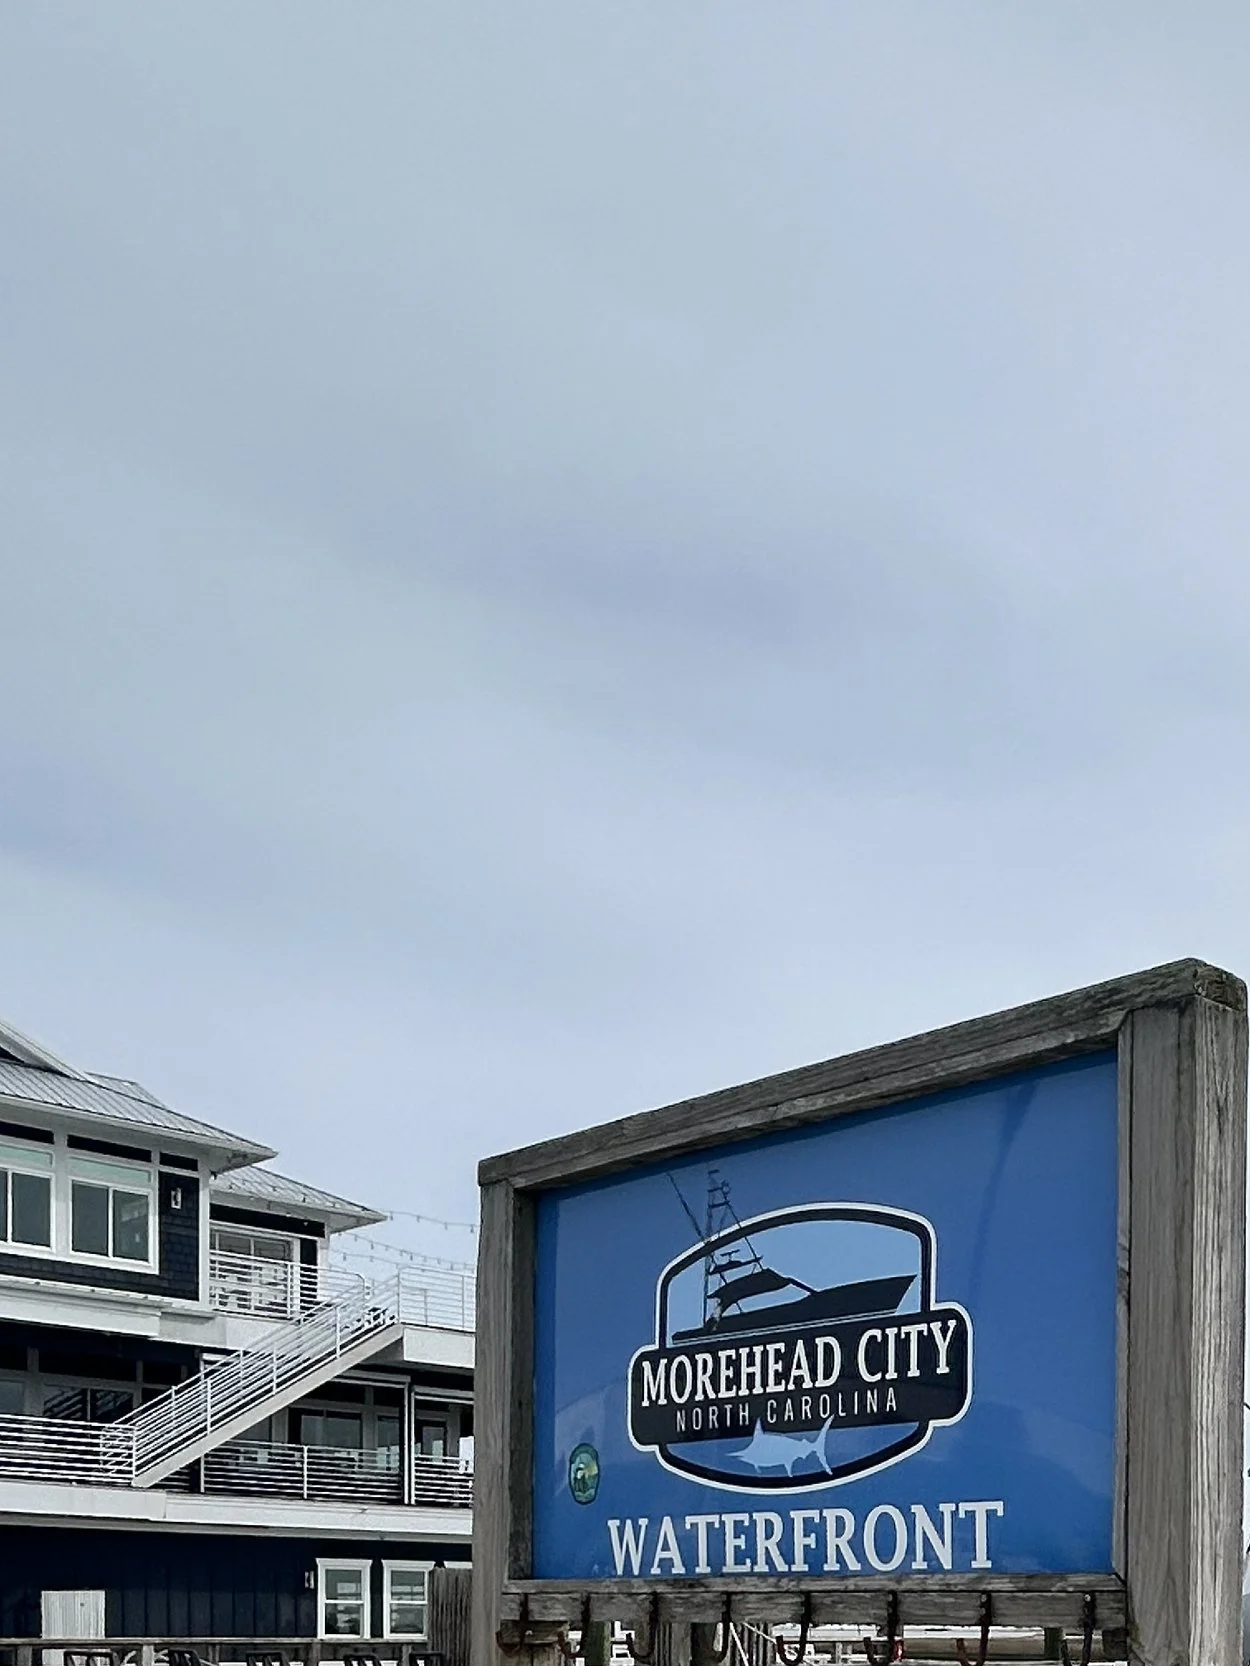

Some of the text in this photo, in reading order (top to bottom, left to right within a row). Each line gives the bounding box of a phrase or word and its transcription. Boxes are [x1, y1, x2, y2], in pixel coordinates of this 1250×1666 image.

[642, 1320, 957, 1406] MOREHEAD CITY
[676, 1387, 898, 1432] NORTH CAROLINA
[607, 1500, 1004, 1576] WATERFRONT
